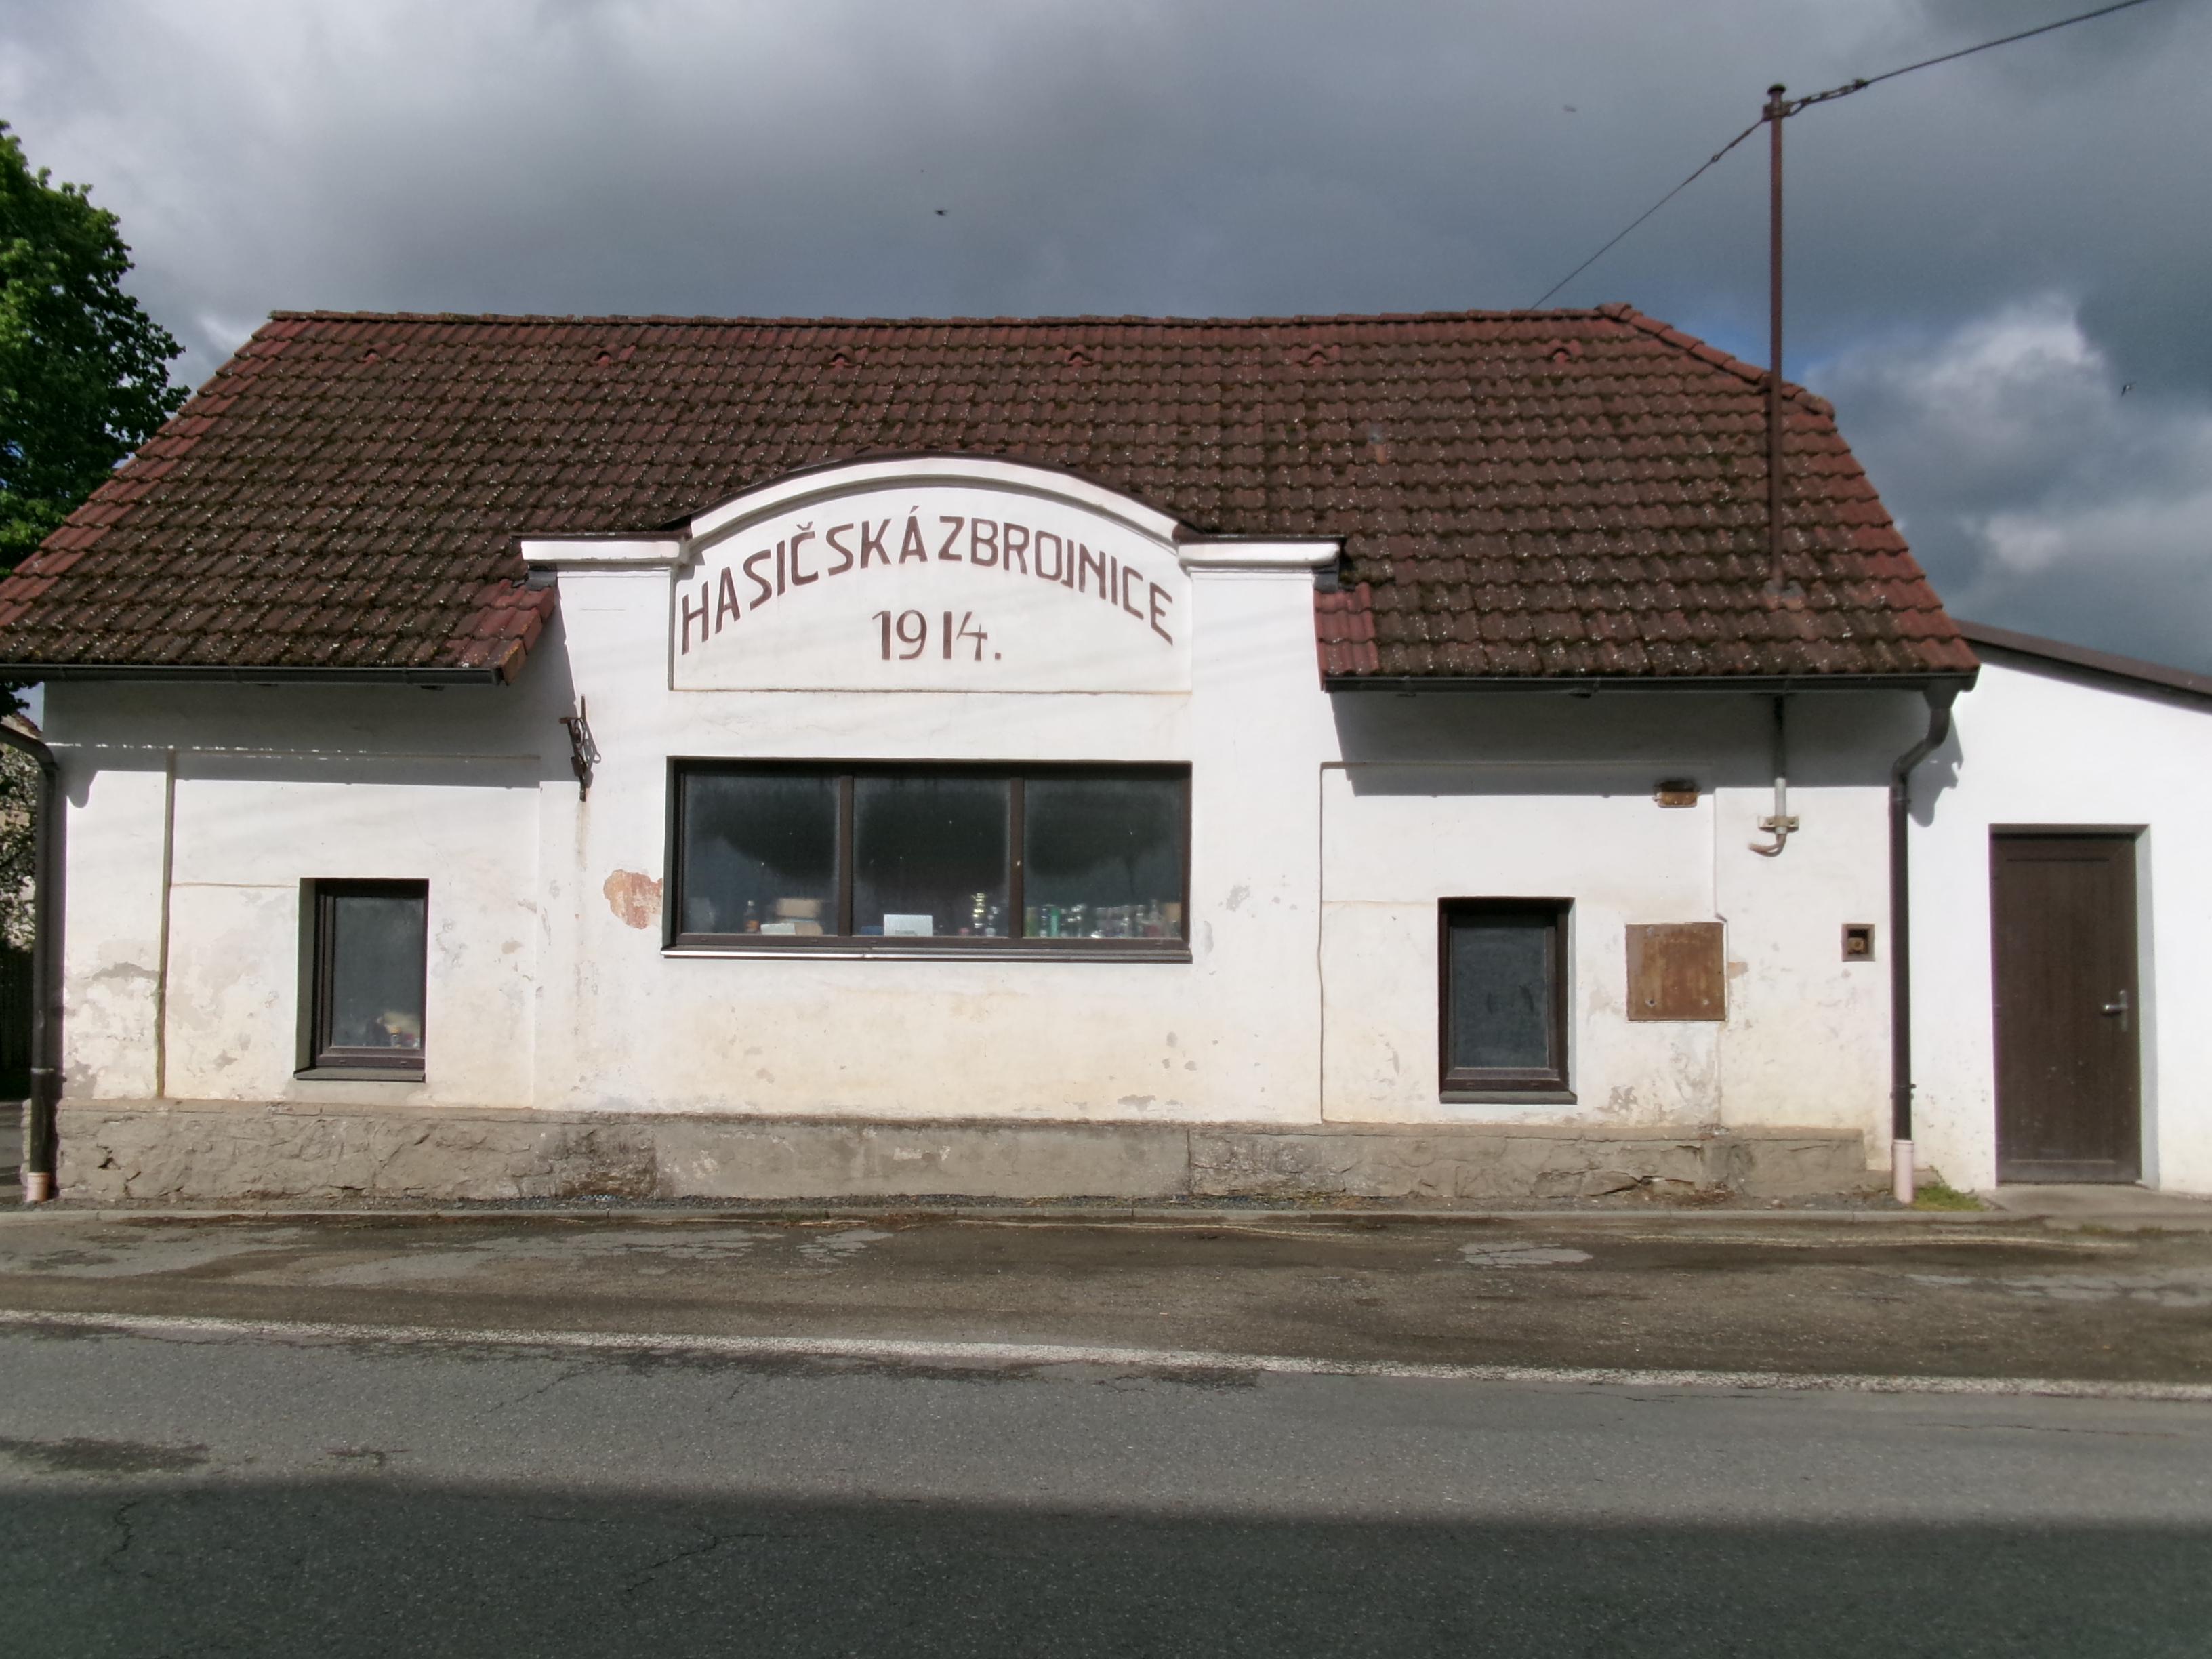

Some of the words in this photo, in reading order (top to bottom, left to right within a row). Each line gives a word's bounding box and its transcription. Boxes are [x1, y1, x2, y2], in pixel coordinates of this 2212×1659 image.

[682, 505, 928, 655] HASIČSKÁ
[938, 516, 1174, 646] ZBROJNICE
[872, 609, 1001, 661] 1914.
